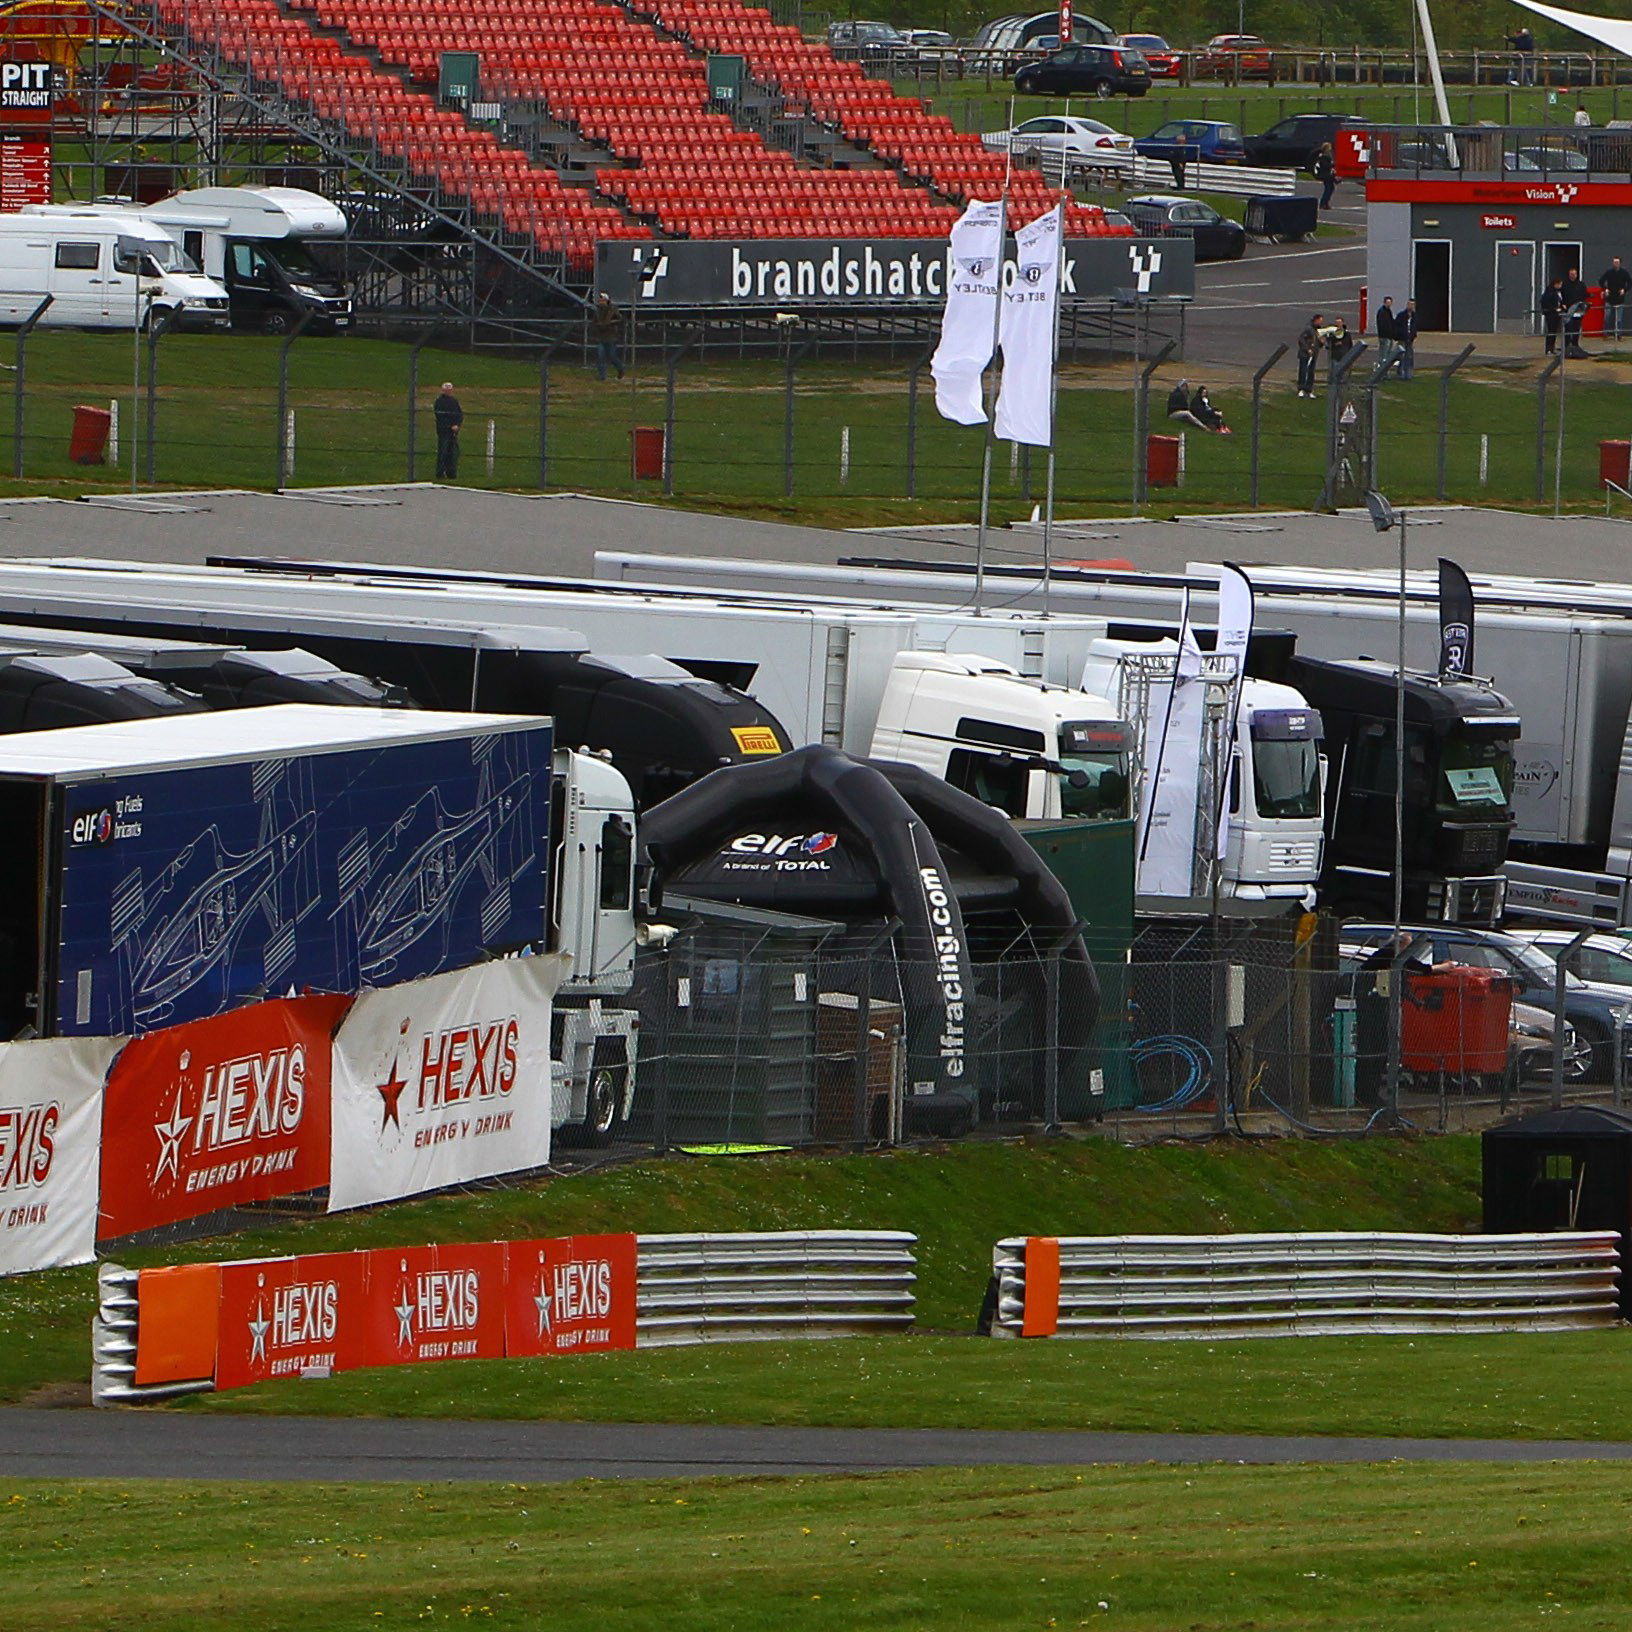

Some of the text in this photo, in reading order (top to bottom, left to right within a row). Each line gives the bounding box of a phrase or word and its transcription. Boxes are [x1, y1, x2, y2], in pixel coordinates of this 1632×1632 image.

[2, 63, 50, 88] PIT
[2, 90, 50, 106] STRAIGHT
[1525, 189, 1555, 199] Vision
[1484, 216, 1513, 227] Toilets
[739, 734, 776, 751] PIRELLI
[125, 795, 143, 813] Fuels
[73, 813, 97, 843] elf
[731, 832, 804, 856] elf
[731, 861, 760, 870] brand
[775, 860, 831, 871] TOTAL
[920, 866, 965, 1078] elfracing.com
[416, 1014, 520, 1114] HEXIS
[191, 1042, 306, 1156] HEXIS
[473, 1110, 515, 1137] DRINK
[0, 1100, 61, 1193] EXIS
[185, 1147, 298, 1194] ENERGY DRINK
[8, 1202, 49, 1228] DRINK
[416, 1269, 480, 1332] HEXIS
[552, 1258, 612, 1323] HEXIS
[272, 1281, 338, 1349] HEXIS
[419, 1339, 478, 1359] ENERGY DRINK
[556, 1328, 611, 1349] ENERGY DRINK
[271, 1355, 308, 1375] ENERGY
